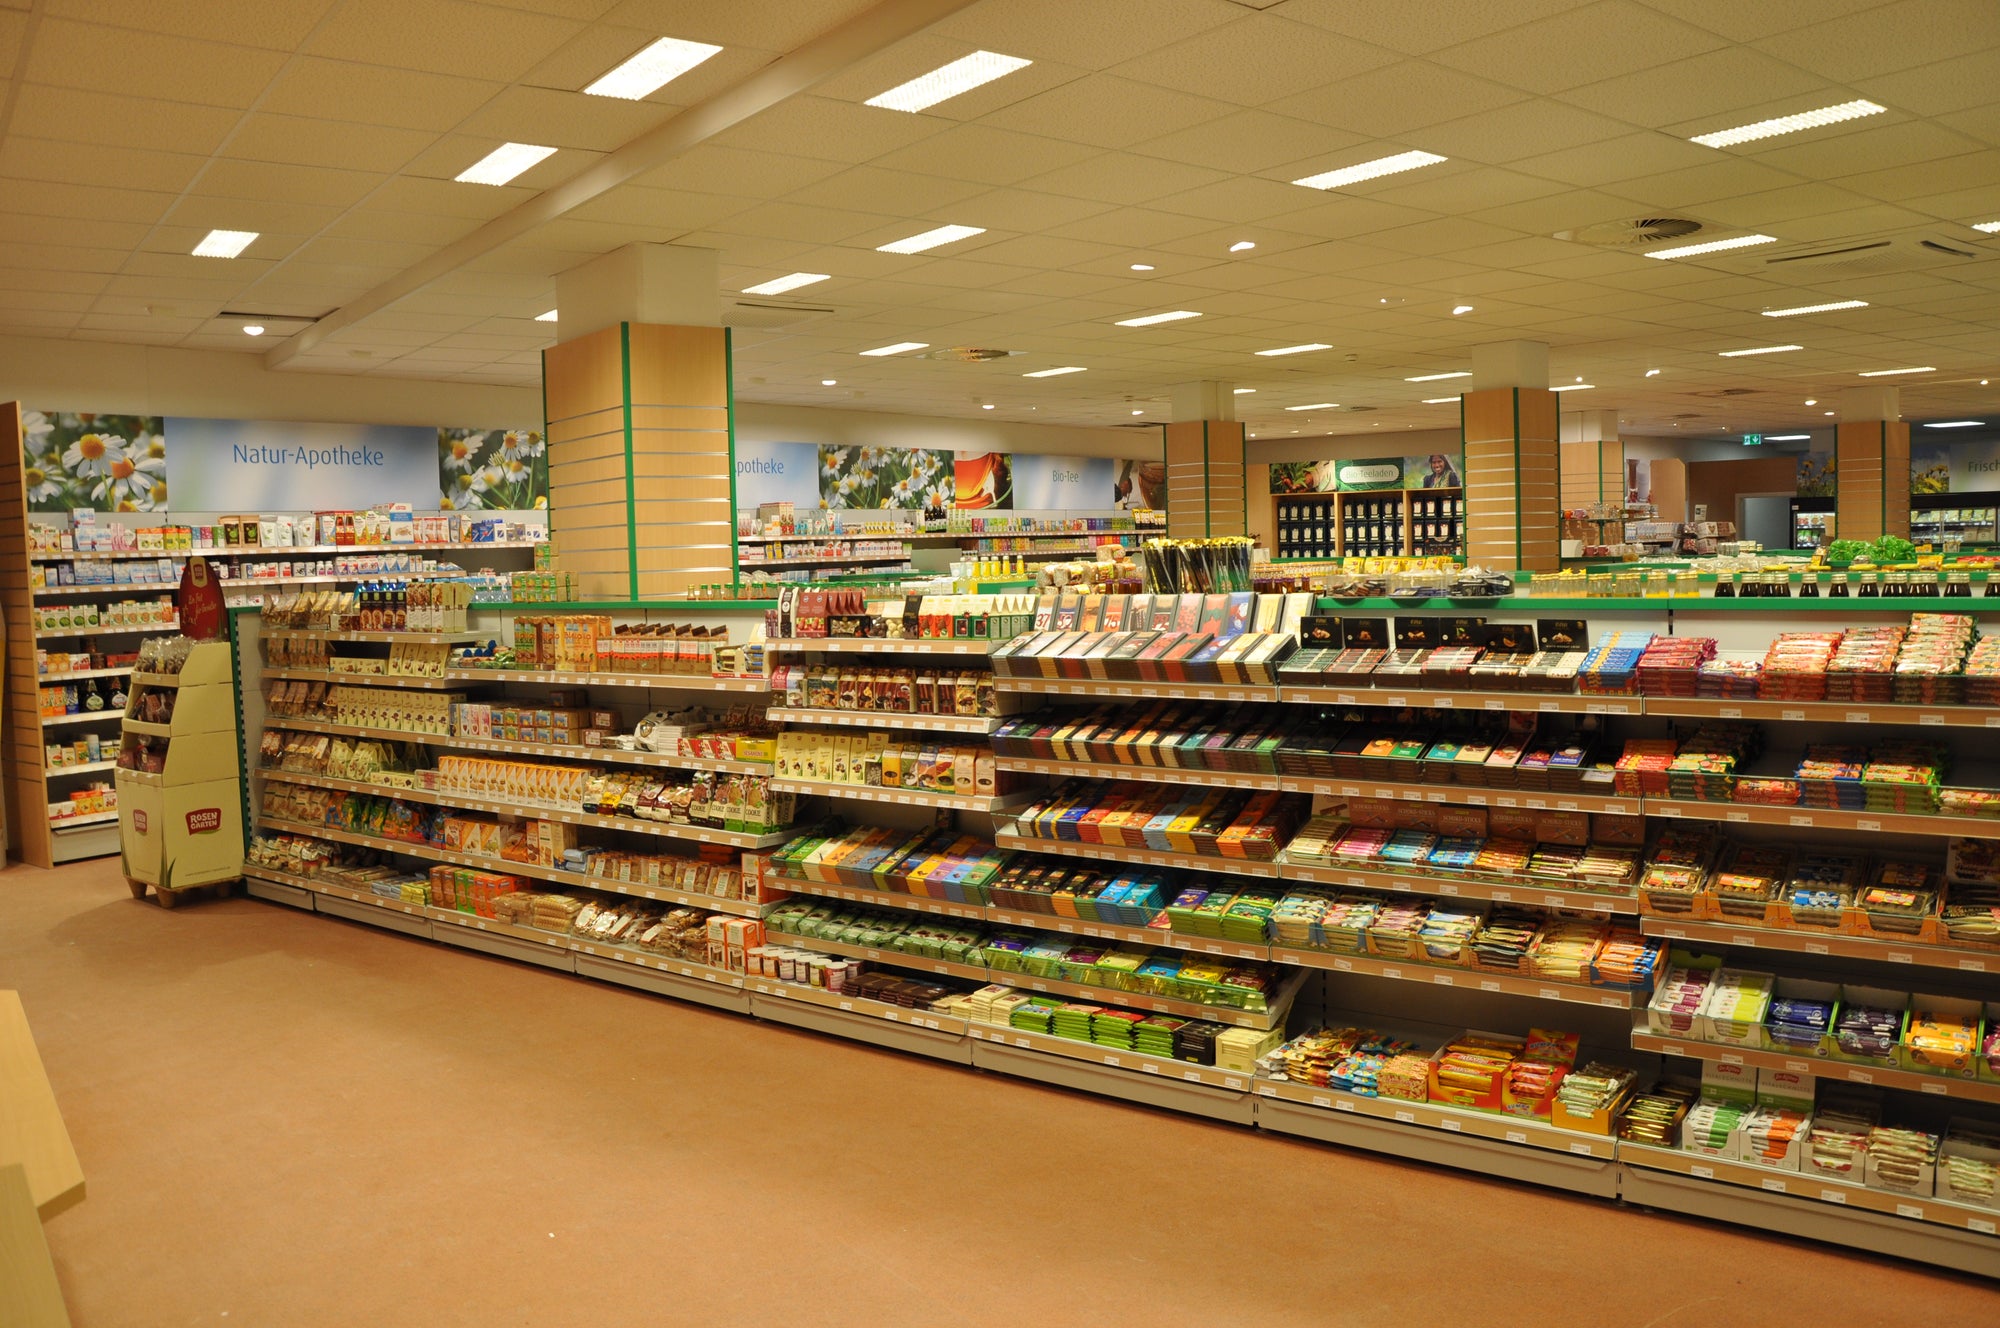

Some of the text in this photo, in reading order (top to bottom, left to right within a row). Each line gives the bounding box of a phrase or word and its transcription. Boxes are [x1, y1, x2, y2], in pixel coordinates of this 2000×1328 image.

[233, 444, 384, 469] Natur-Apotheke
[735, 457, 784, 477] potheke
[1052, 470, 1079, 483] Bio-Tee
[1036, 613, 1050, 628] 37
[1104, 614, 1120, 629] 75
[190, 811, 218, 823] ROSEN
[745, 808, 761, 817] COOKIE
[190, 820, 218, 830] GARTEN
